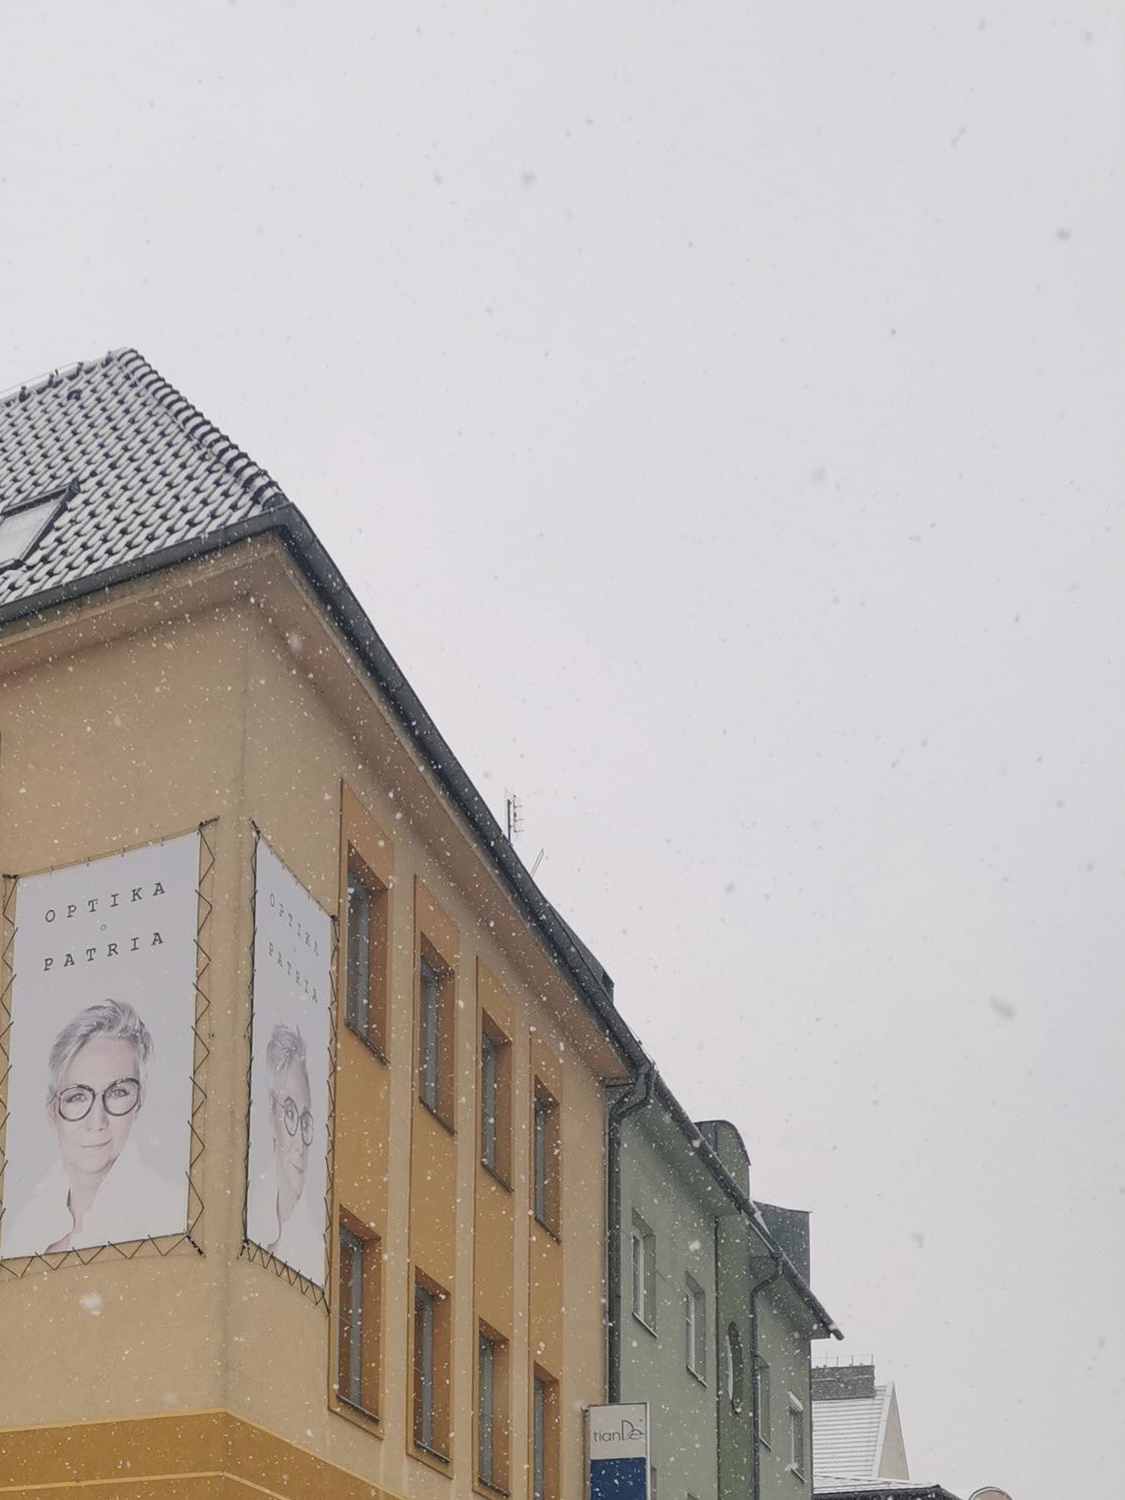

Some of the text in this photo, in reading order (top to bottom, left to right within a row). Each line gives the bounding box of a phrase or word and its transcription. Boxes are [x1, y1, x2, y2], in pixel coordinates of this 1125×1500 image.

[44, 881, 166, 923] OPTIKA
[43, 931, 164, 972] PATRIA
[267, 940, 319, 1004] PATRIA
